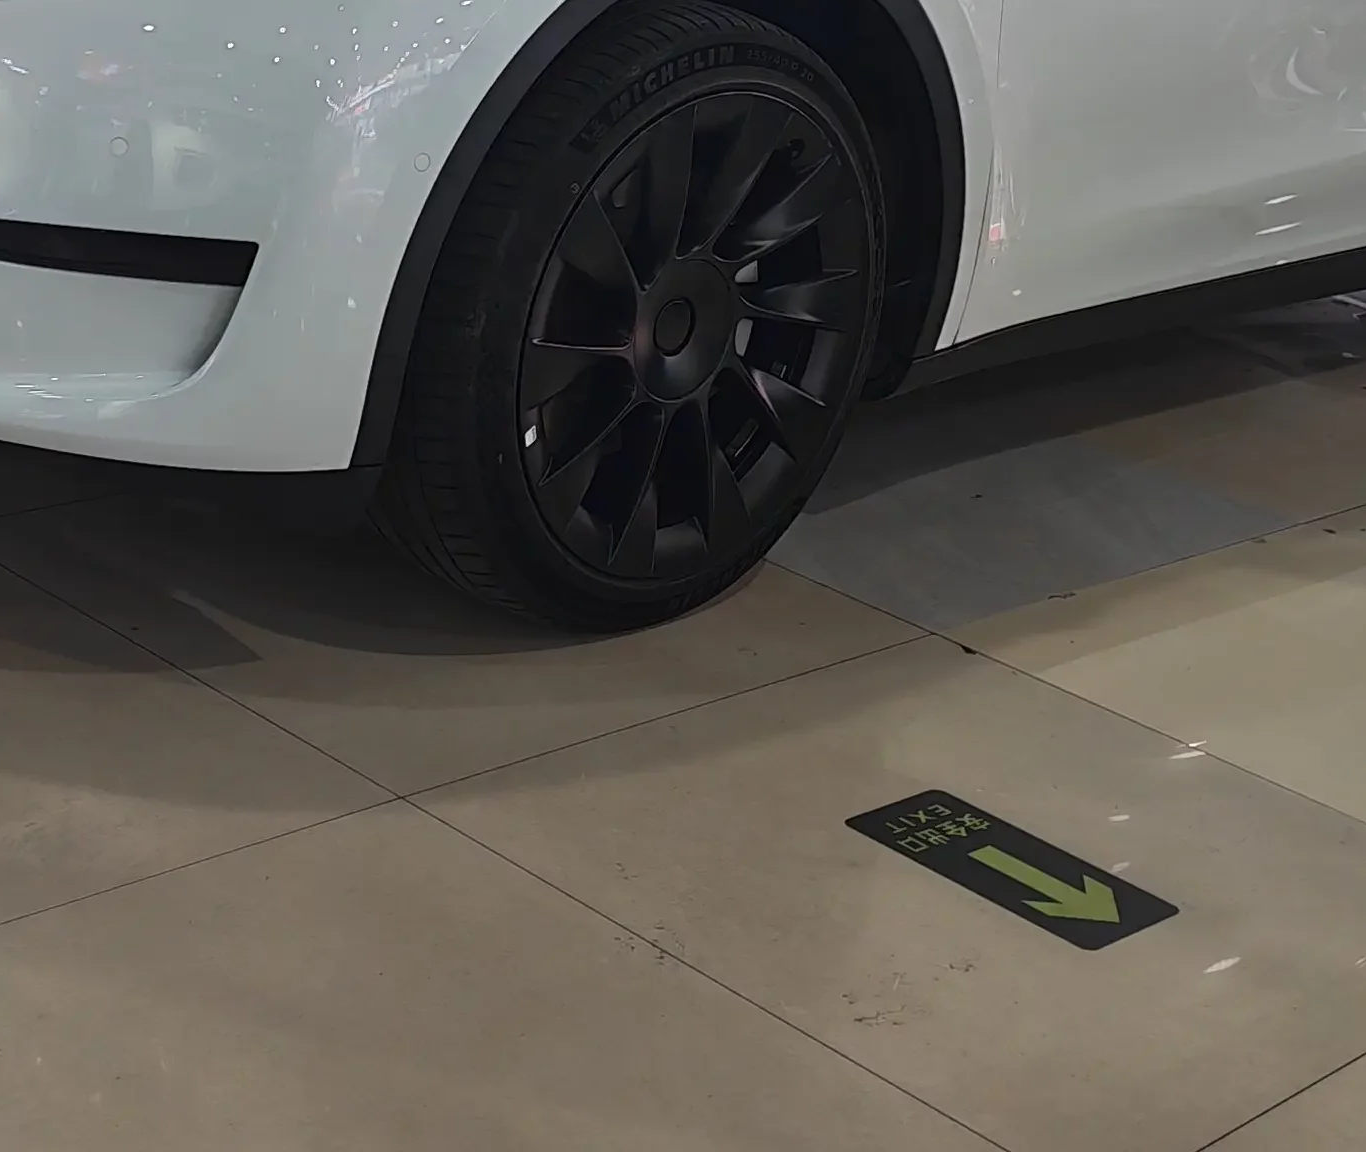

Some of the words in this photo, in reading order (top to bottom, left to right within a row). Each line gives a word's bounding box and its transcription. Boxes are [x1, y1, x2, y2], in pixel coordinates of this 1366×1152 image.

[609, 45, 736, 123] MICHELIN
[885, 803, 952, 834] EXIT
[895, 813, 991, 853] 安全出口
